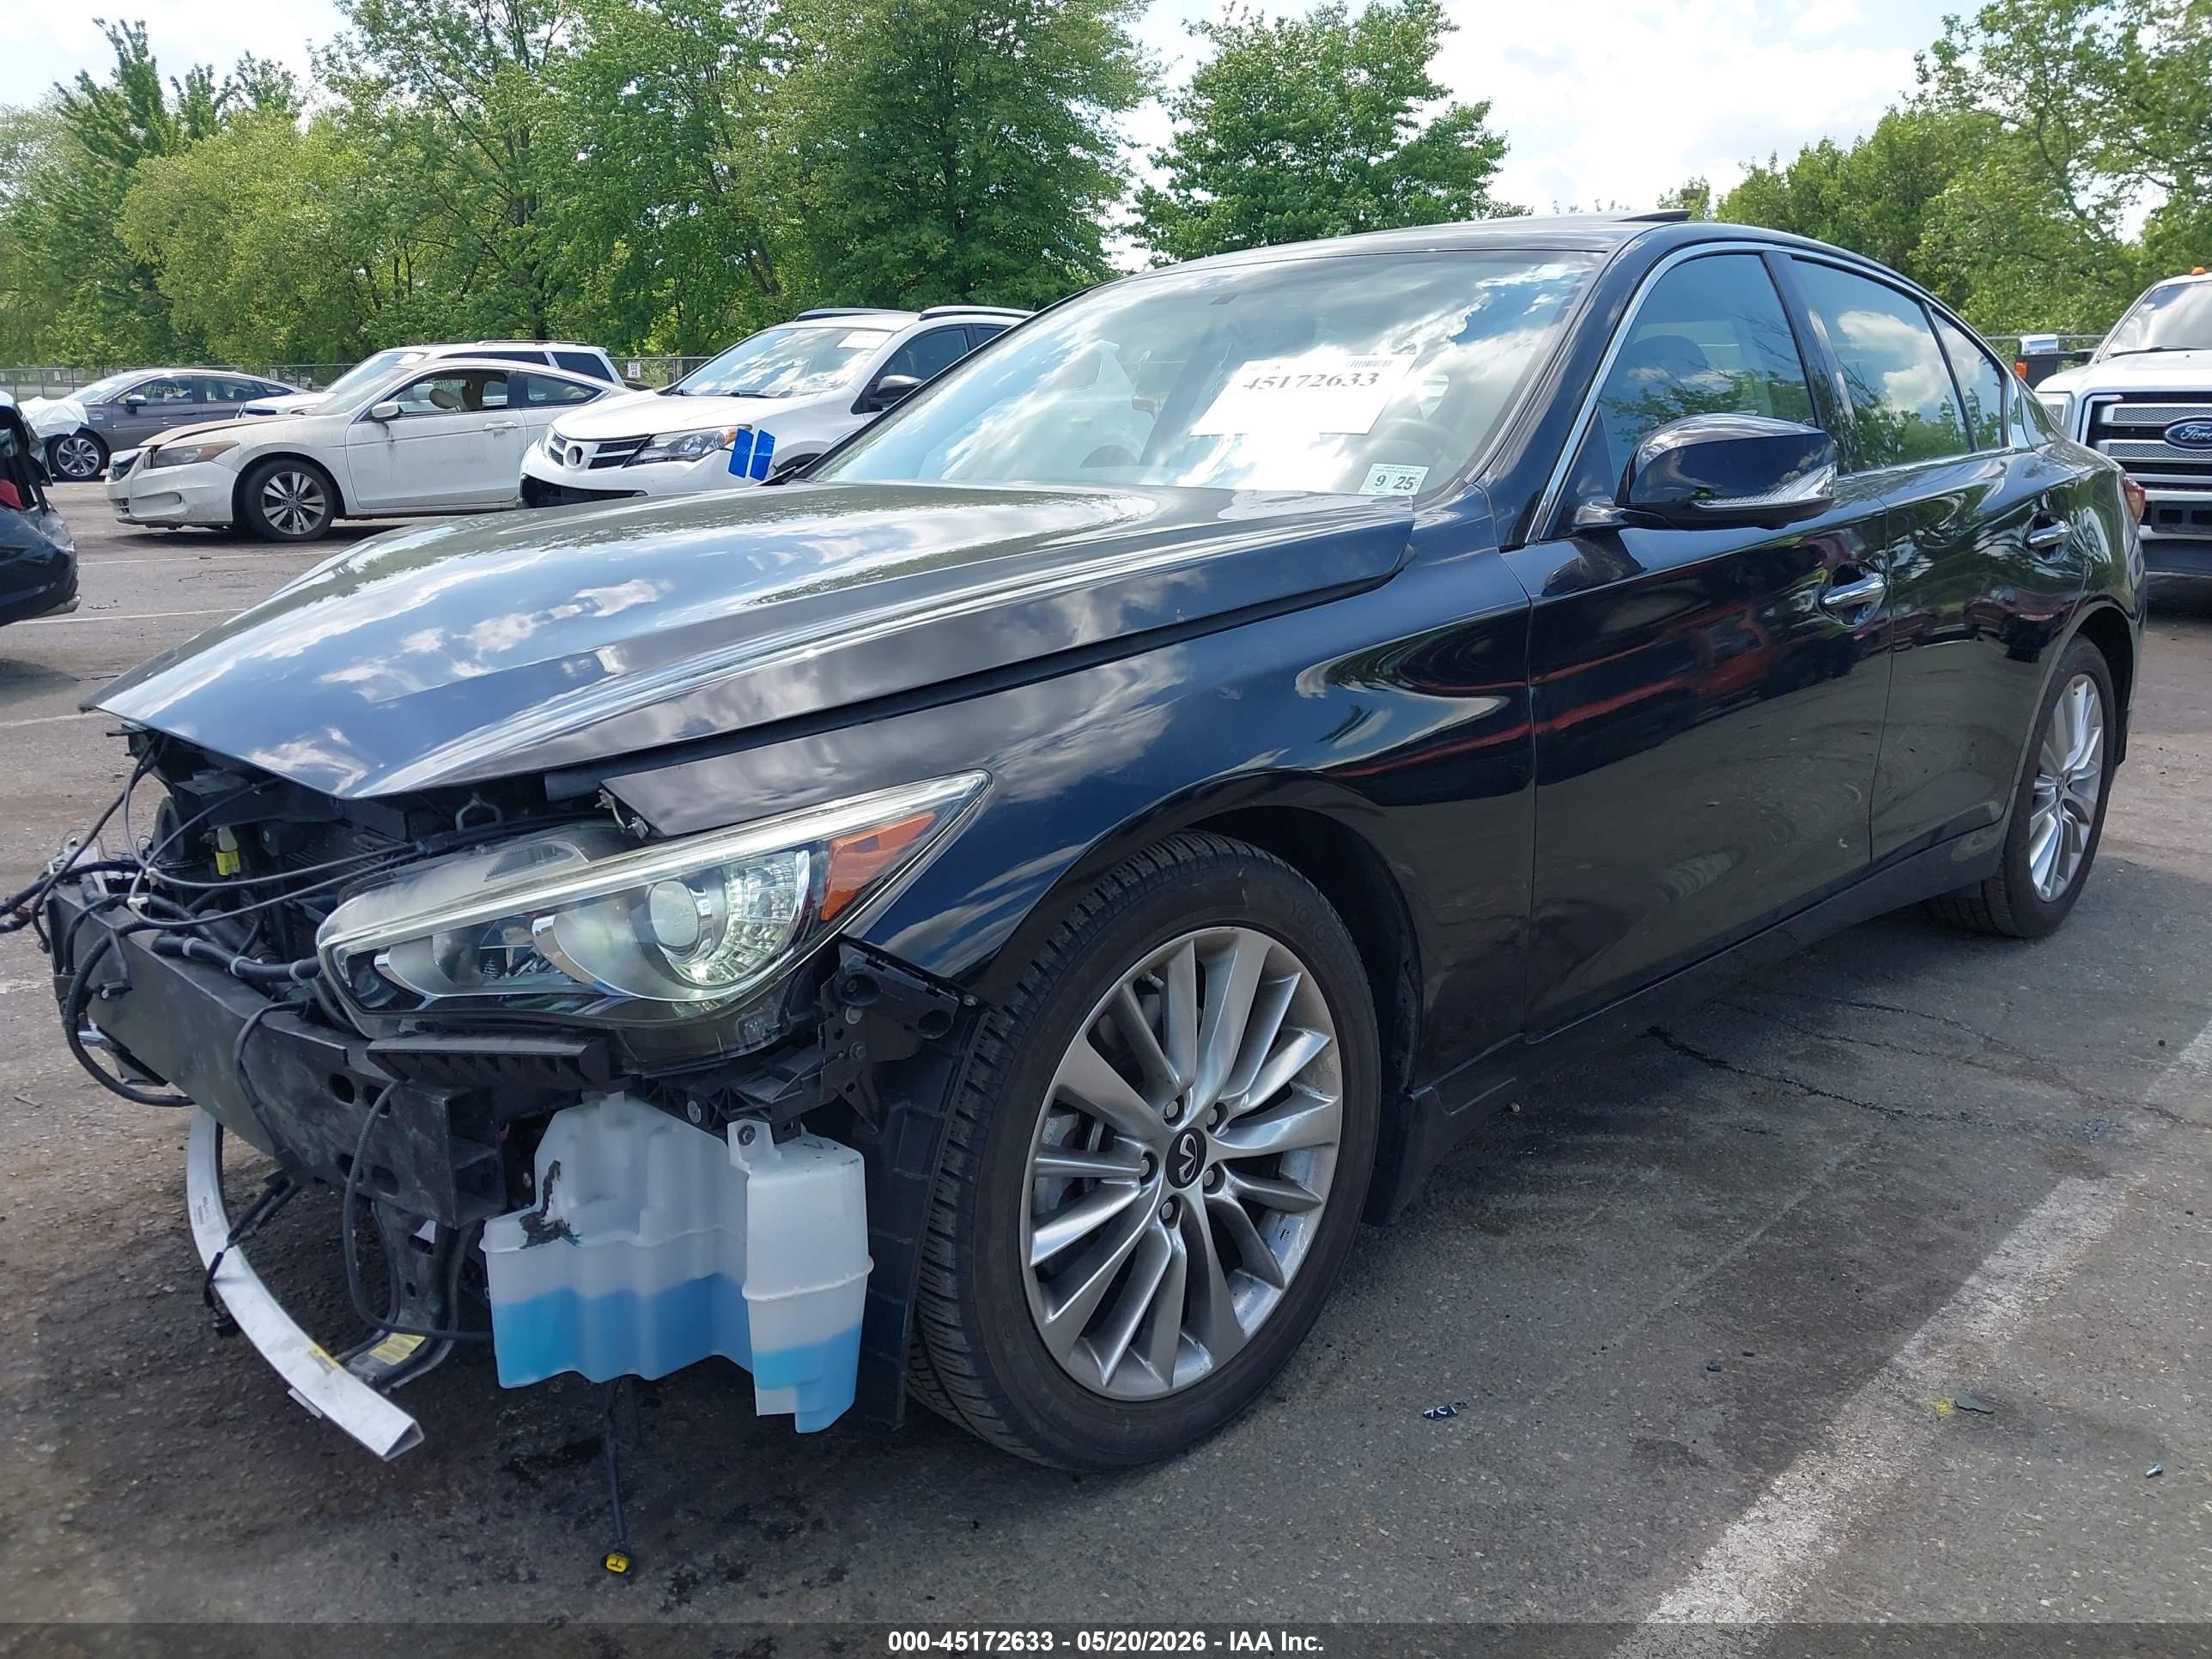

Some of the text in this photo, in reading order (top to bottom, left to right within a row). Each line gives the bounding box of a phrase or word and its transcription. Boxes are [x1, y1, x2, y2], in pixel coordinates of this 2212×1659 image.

[1243, 373, 1380, 390] 45172633
[1374, 475, 1416, 490] 9 25
